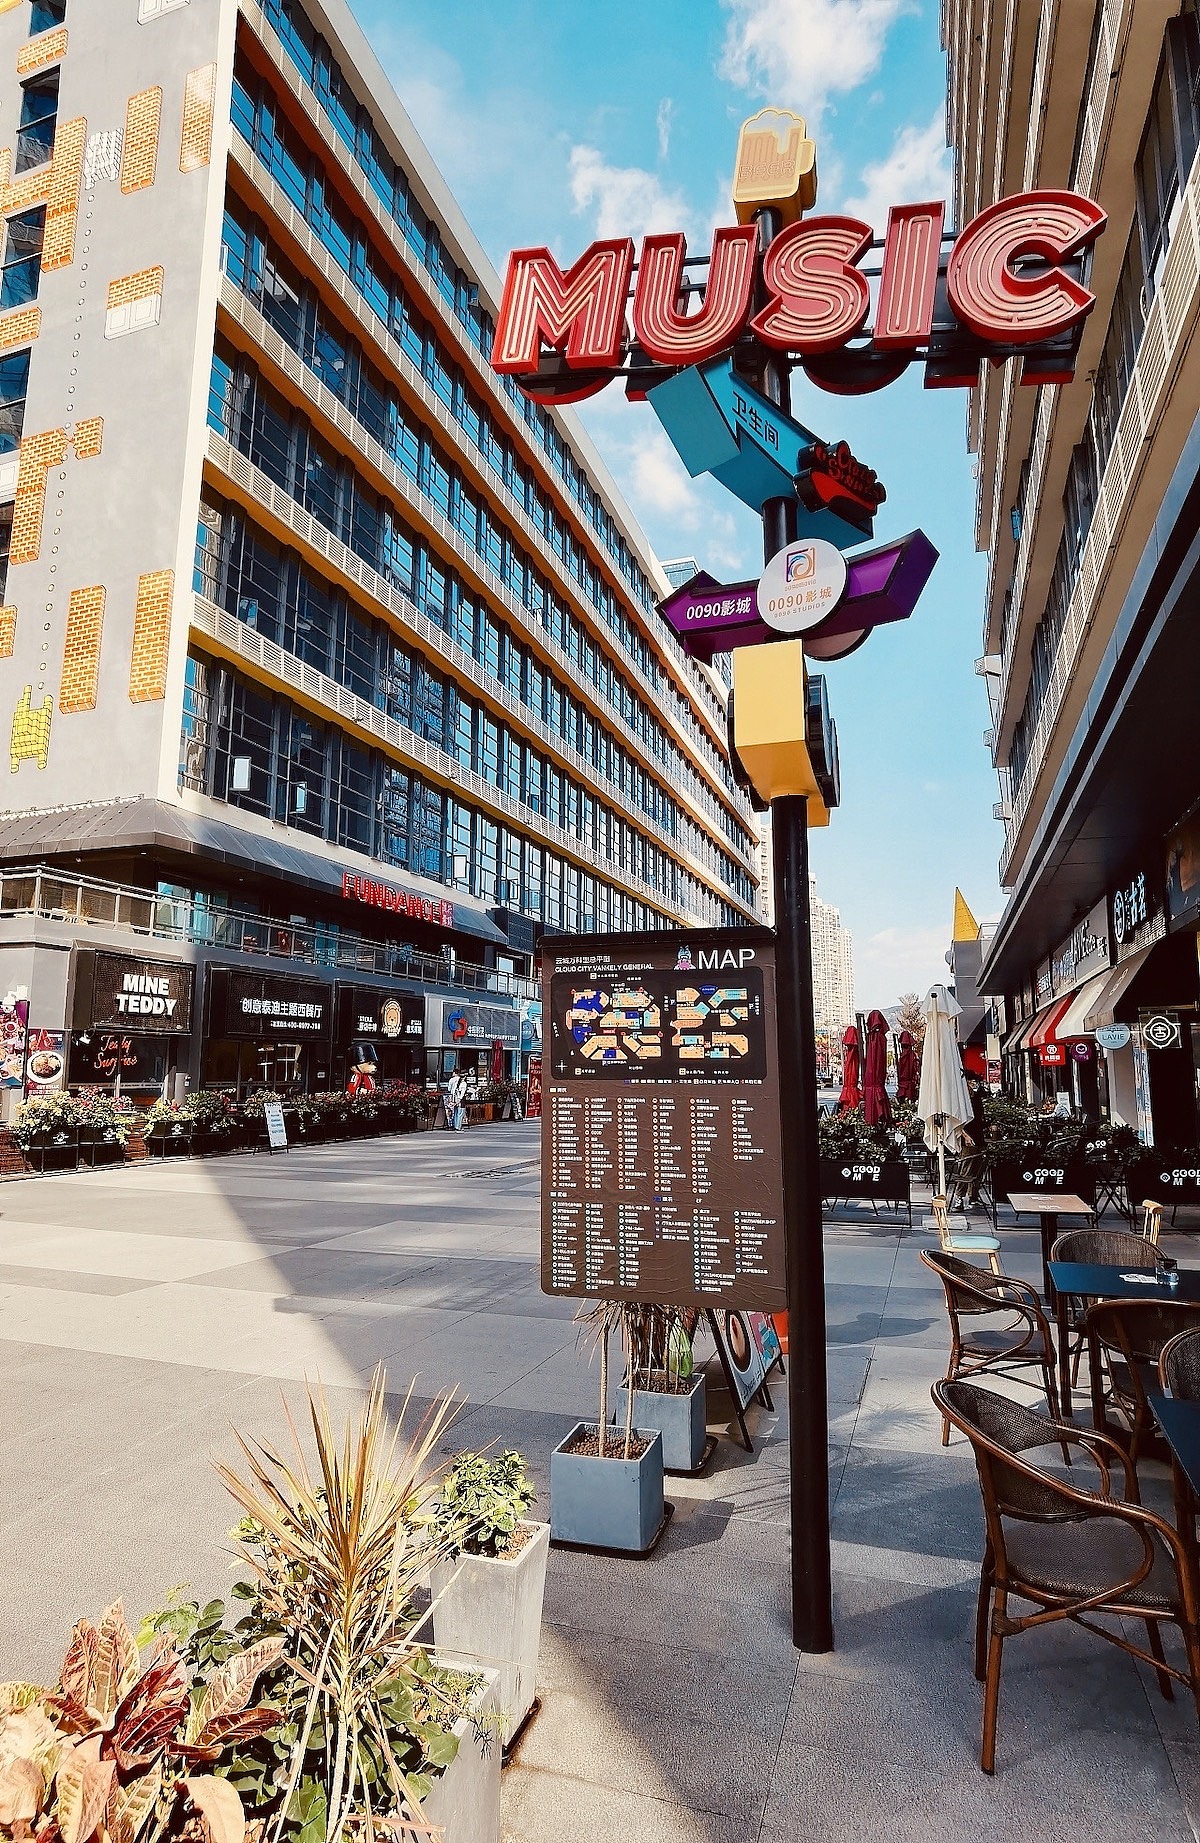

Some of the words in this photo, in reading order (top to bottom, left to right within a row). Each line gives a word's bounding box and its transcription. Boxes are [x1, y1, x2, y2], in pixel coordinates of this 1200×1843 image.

[491, 189, 1108, 375] MUSIC
[732, 391, 779, 451] 卫生间
[686, 596, 752, 620] 0090影城
[768, 586, 832, 612] 0090影城
[792, 601, 826, 614] STUDIOS
[343, 871, 441, 925] FUNDANCE
[554, 966, 577, 974] CLOUD
[622, 962, 655, 971] GENERAL
[698, 948, 756, 970] MAP
[122, 973, 170, 996] MINE
[116, 993, 178, 1017] TEDDY
[241, 998, 322, 1018] 创意泰迪主题西餐厅
[1102, 1033, 1125, 1041] LAVIE
[852, 1165, 881, 1174] GOOD
[1034, 1168, 1064, 1177] GOOD
